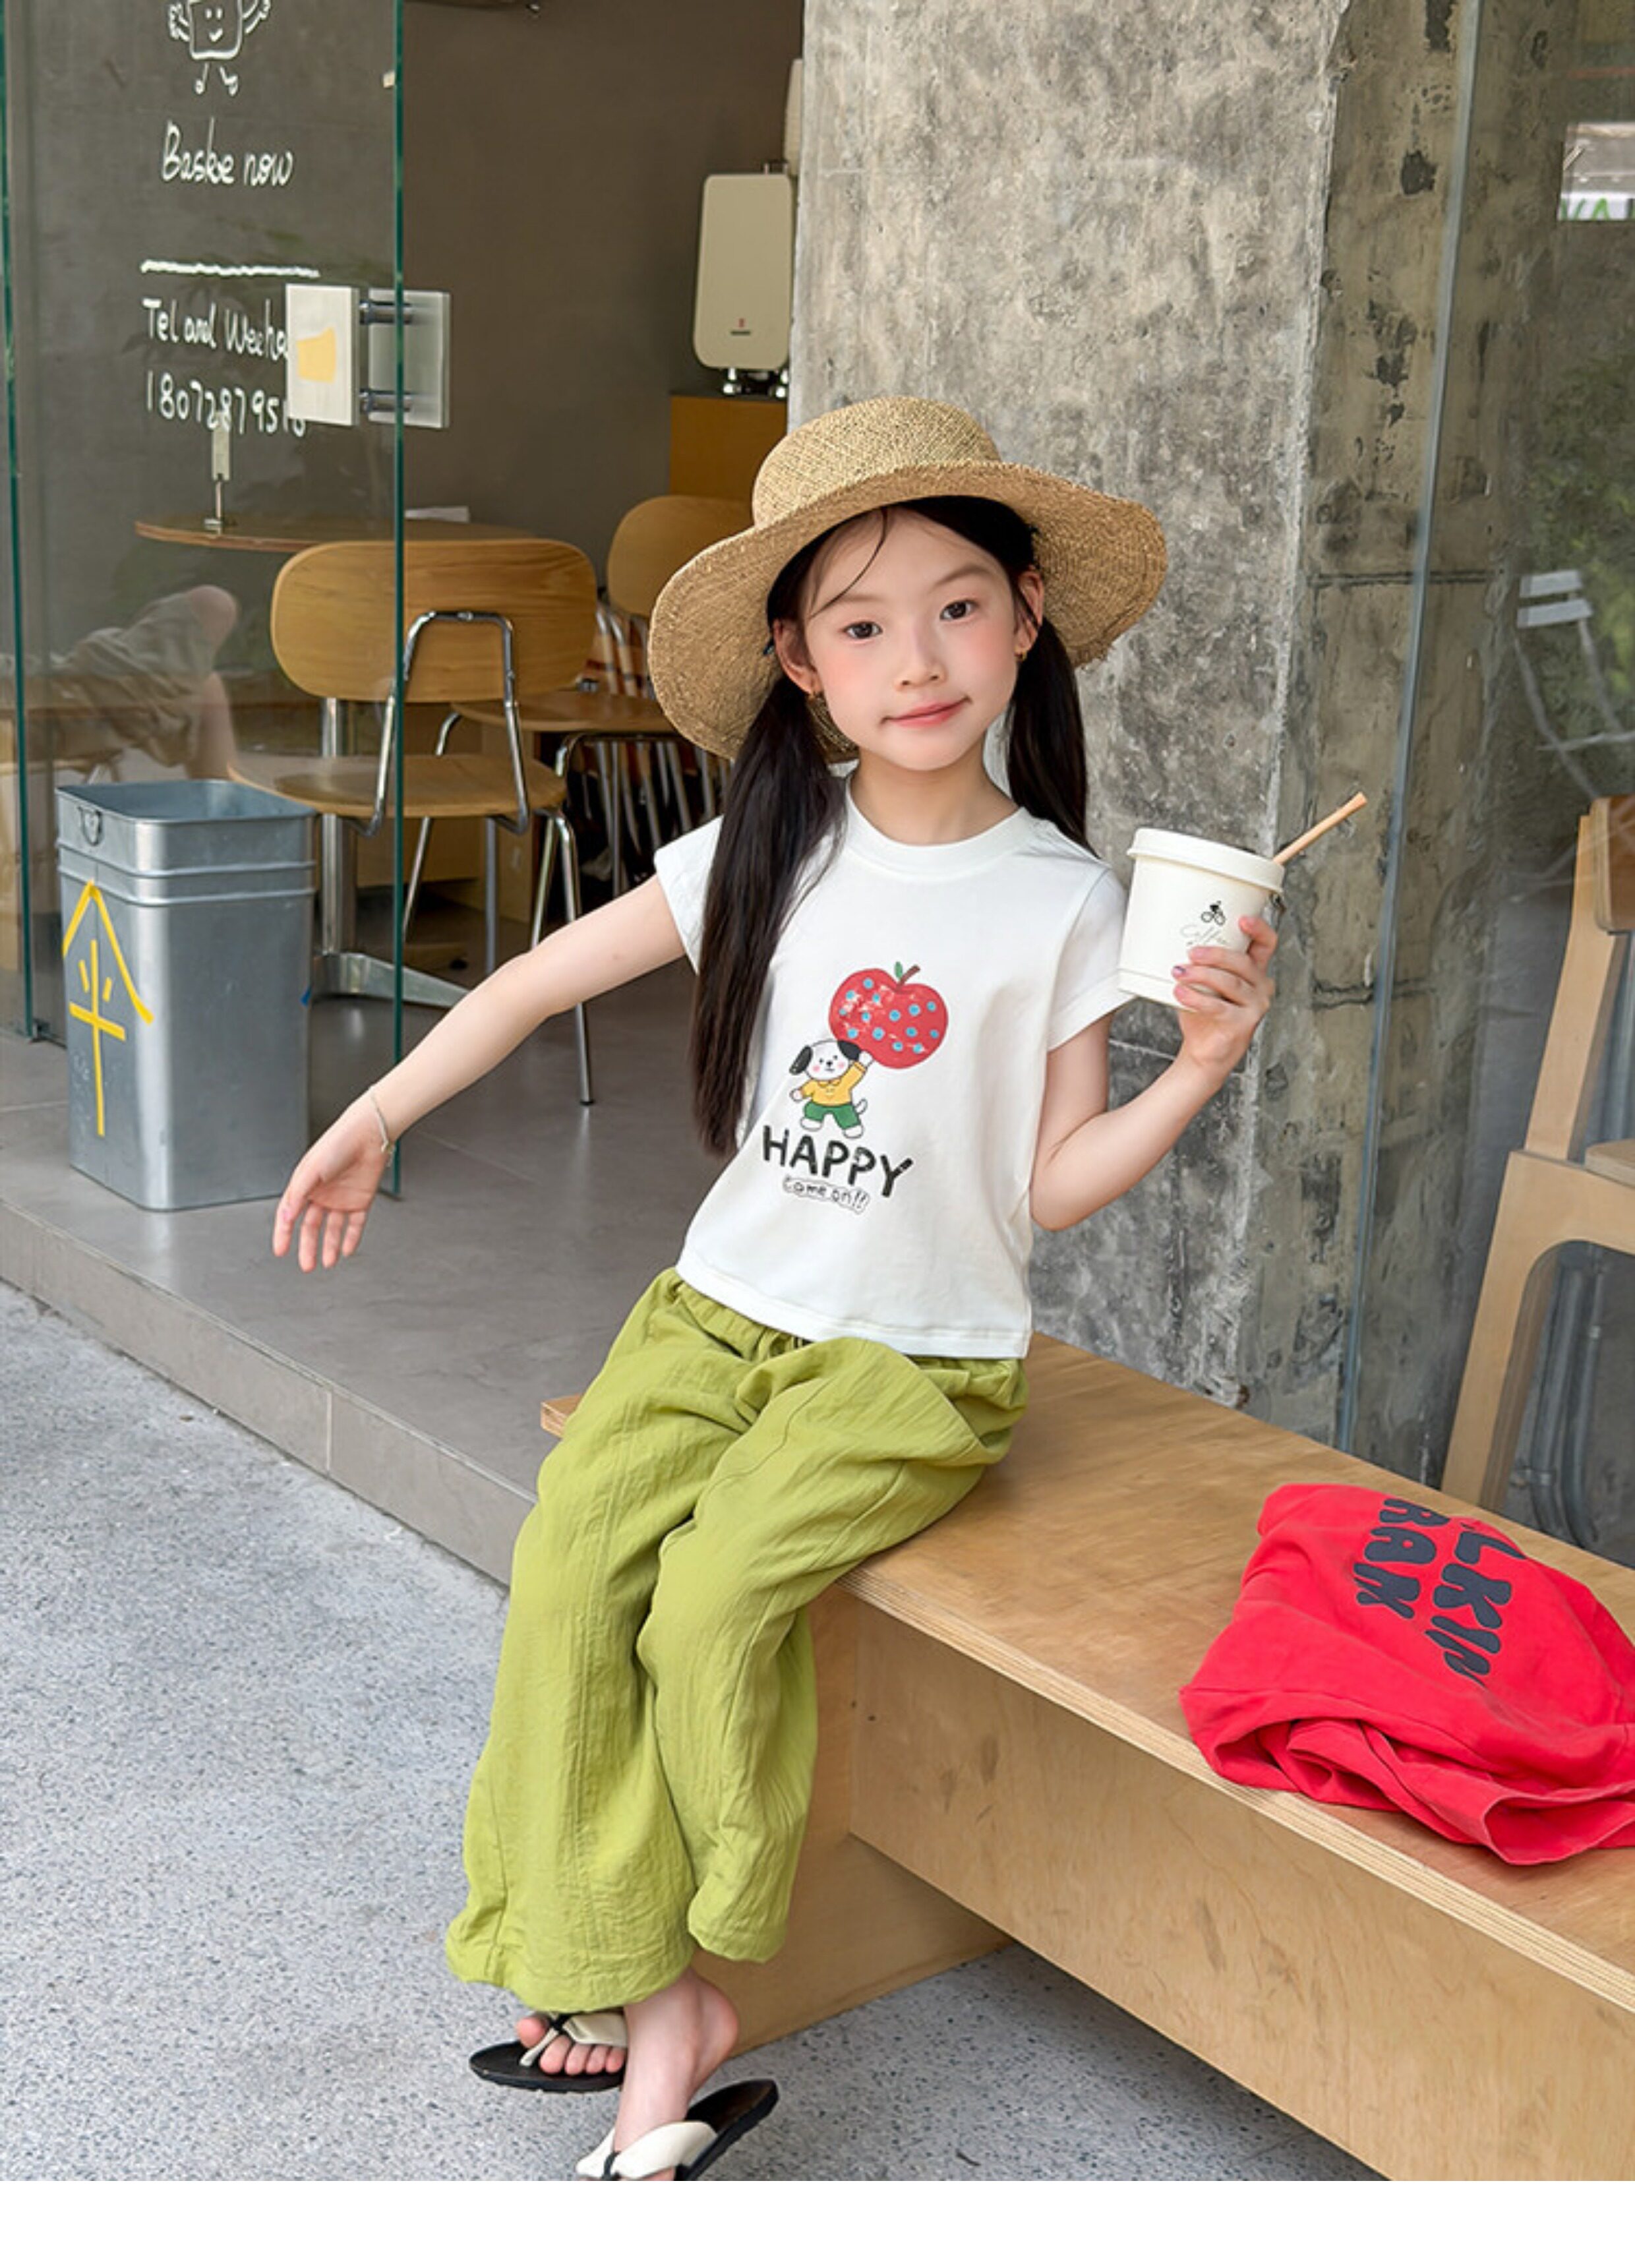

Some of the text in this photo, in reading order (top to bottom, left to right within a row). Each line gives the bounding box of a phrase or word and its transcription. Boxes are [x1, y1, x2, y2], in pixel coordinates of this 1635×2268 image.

[243, 150, 294, 187] now
[141, 298, 288, 361] Tel and Wecha
[763, 1124, 914, 1198] HAPPY
[1424, 1521, 1527, 1688] LKIN
